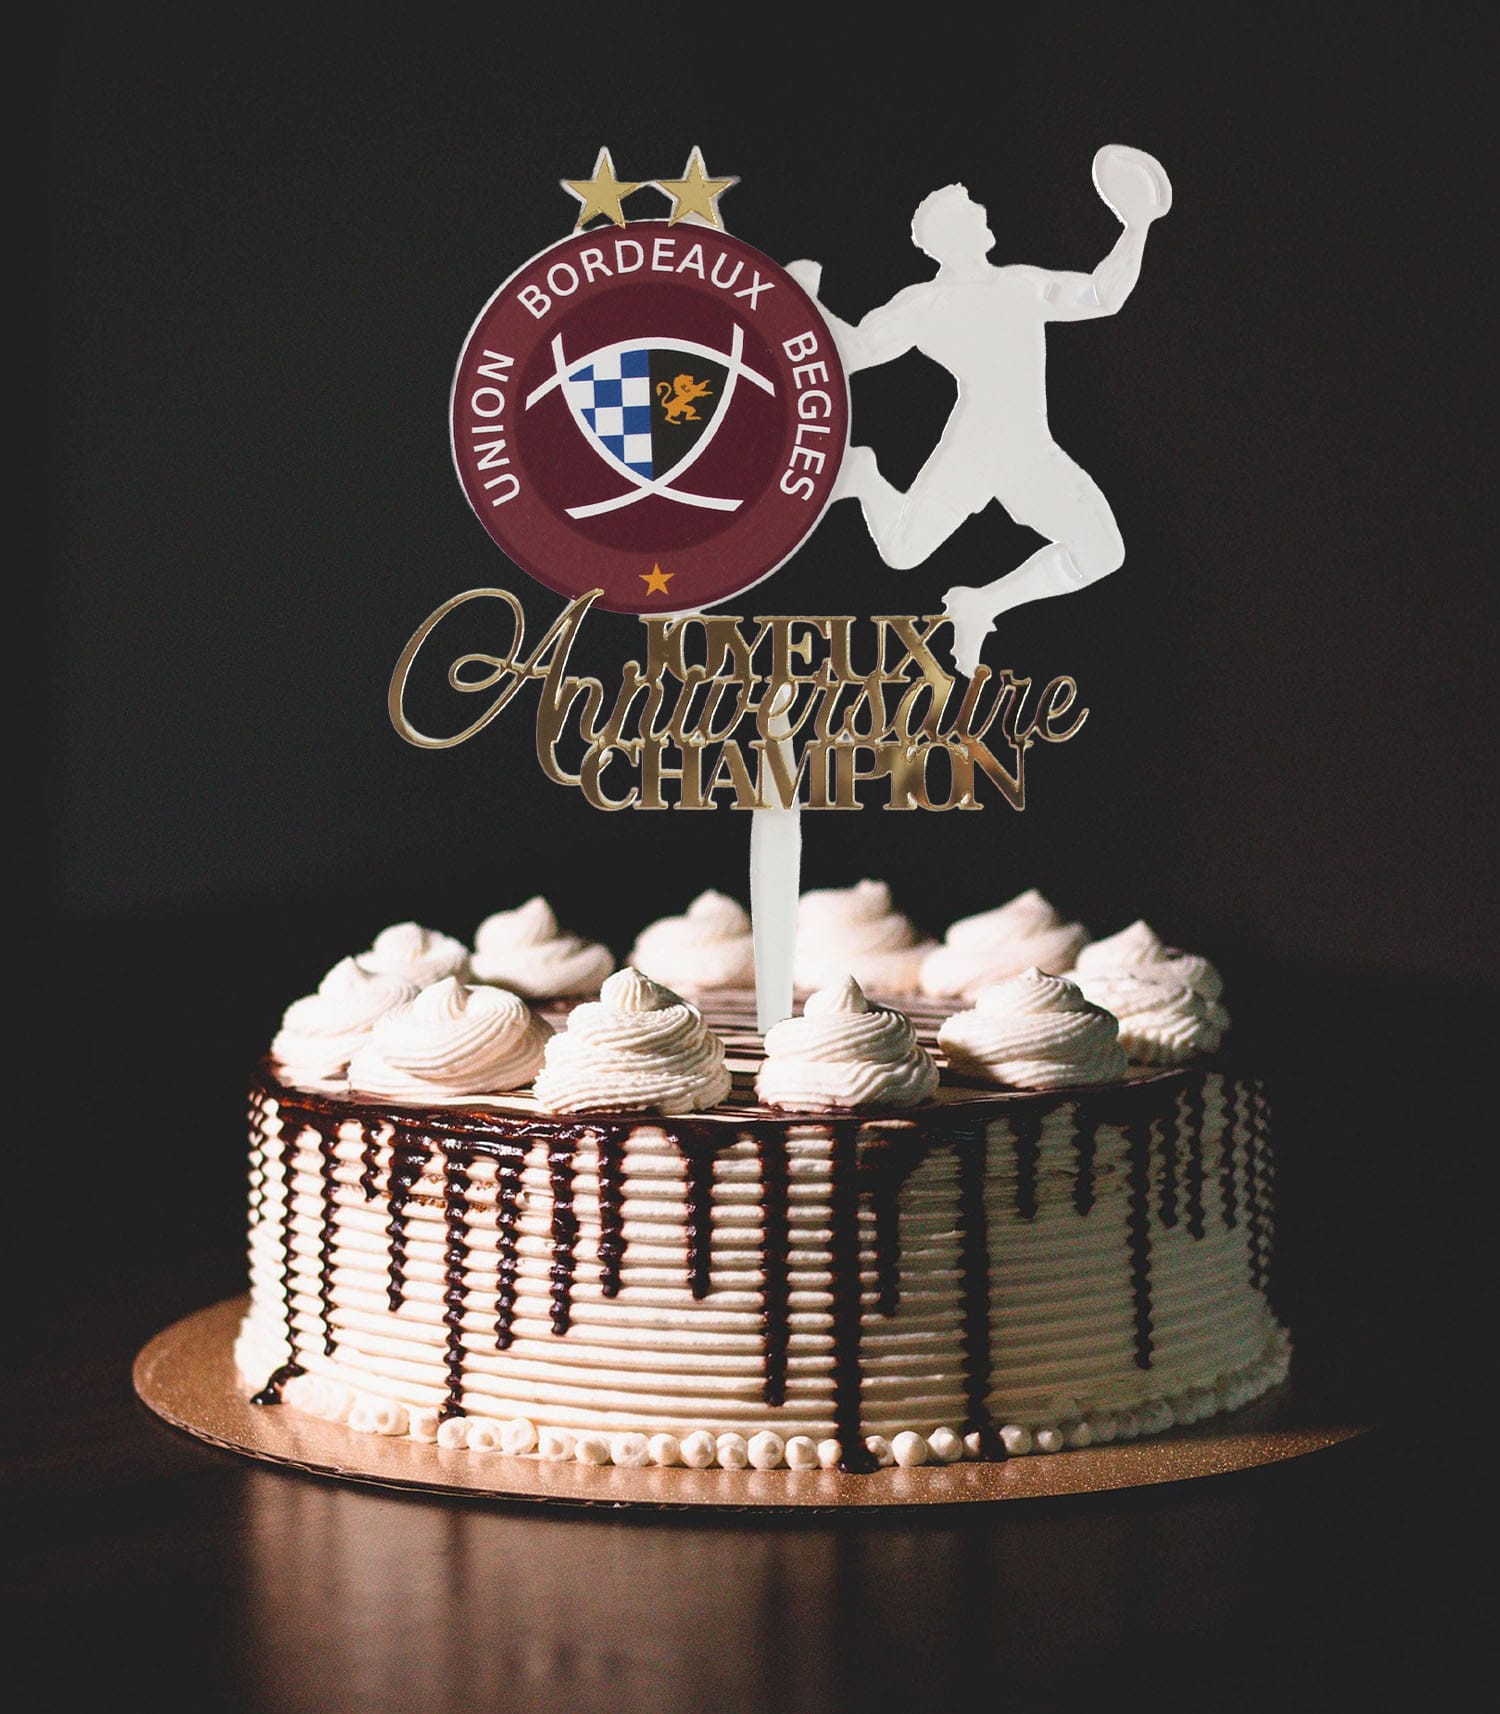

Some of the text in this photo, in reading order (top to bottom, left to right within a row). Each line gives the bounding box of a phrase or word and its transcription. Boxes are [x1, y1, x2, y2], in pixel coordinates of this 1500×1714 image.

[471, 238, 832, 506] UNION BORDEAUX BEGLES
[388, 588, 1089, 786] Anniversaire
[624, 615, 950, 683] JOYEUX
[580, 738, 1033, 811] CHAMPION
